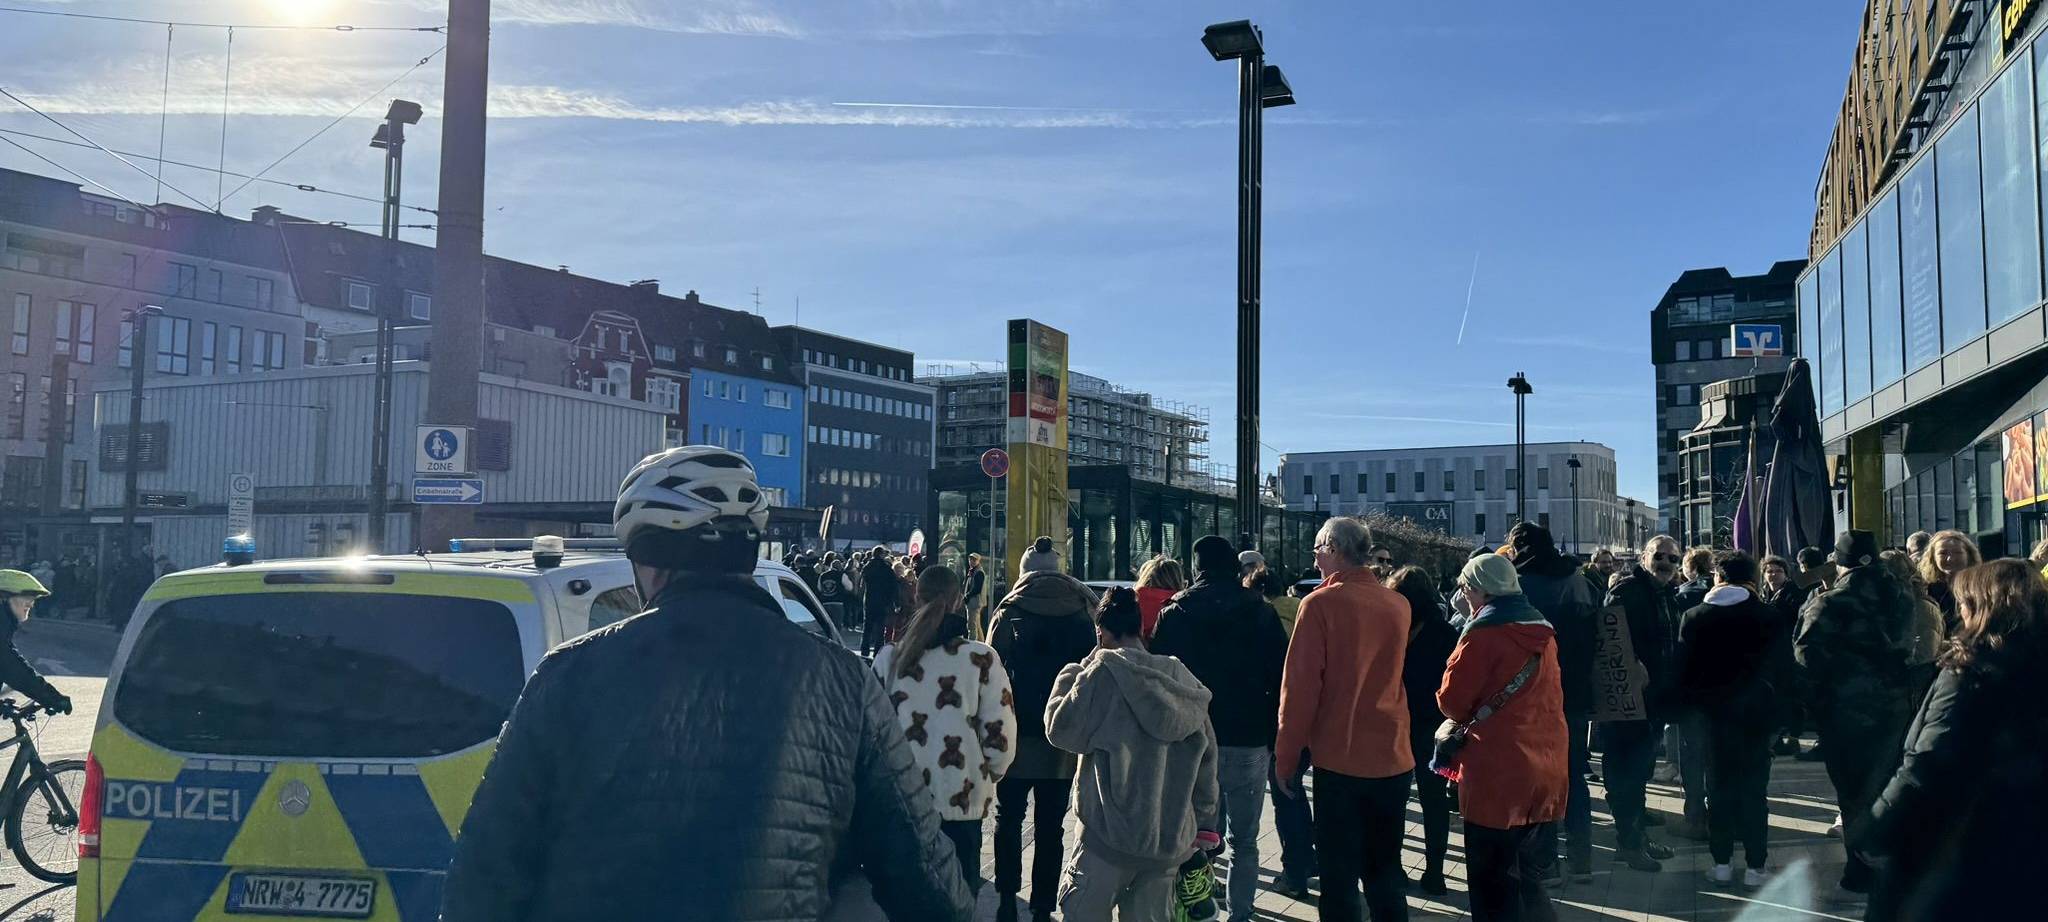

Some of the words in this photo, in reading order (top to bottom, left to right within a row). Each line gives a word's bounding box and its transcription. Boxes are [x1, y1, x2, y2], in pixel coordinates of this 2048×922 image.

[427, 462, 454, 471] ZONE
[416, 486, 463, 496] Einbahnstraße
[105, 782, 240, 822] POLIZEI
[242, 879, 283, 906] NRW
